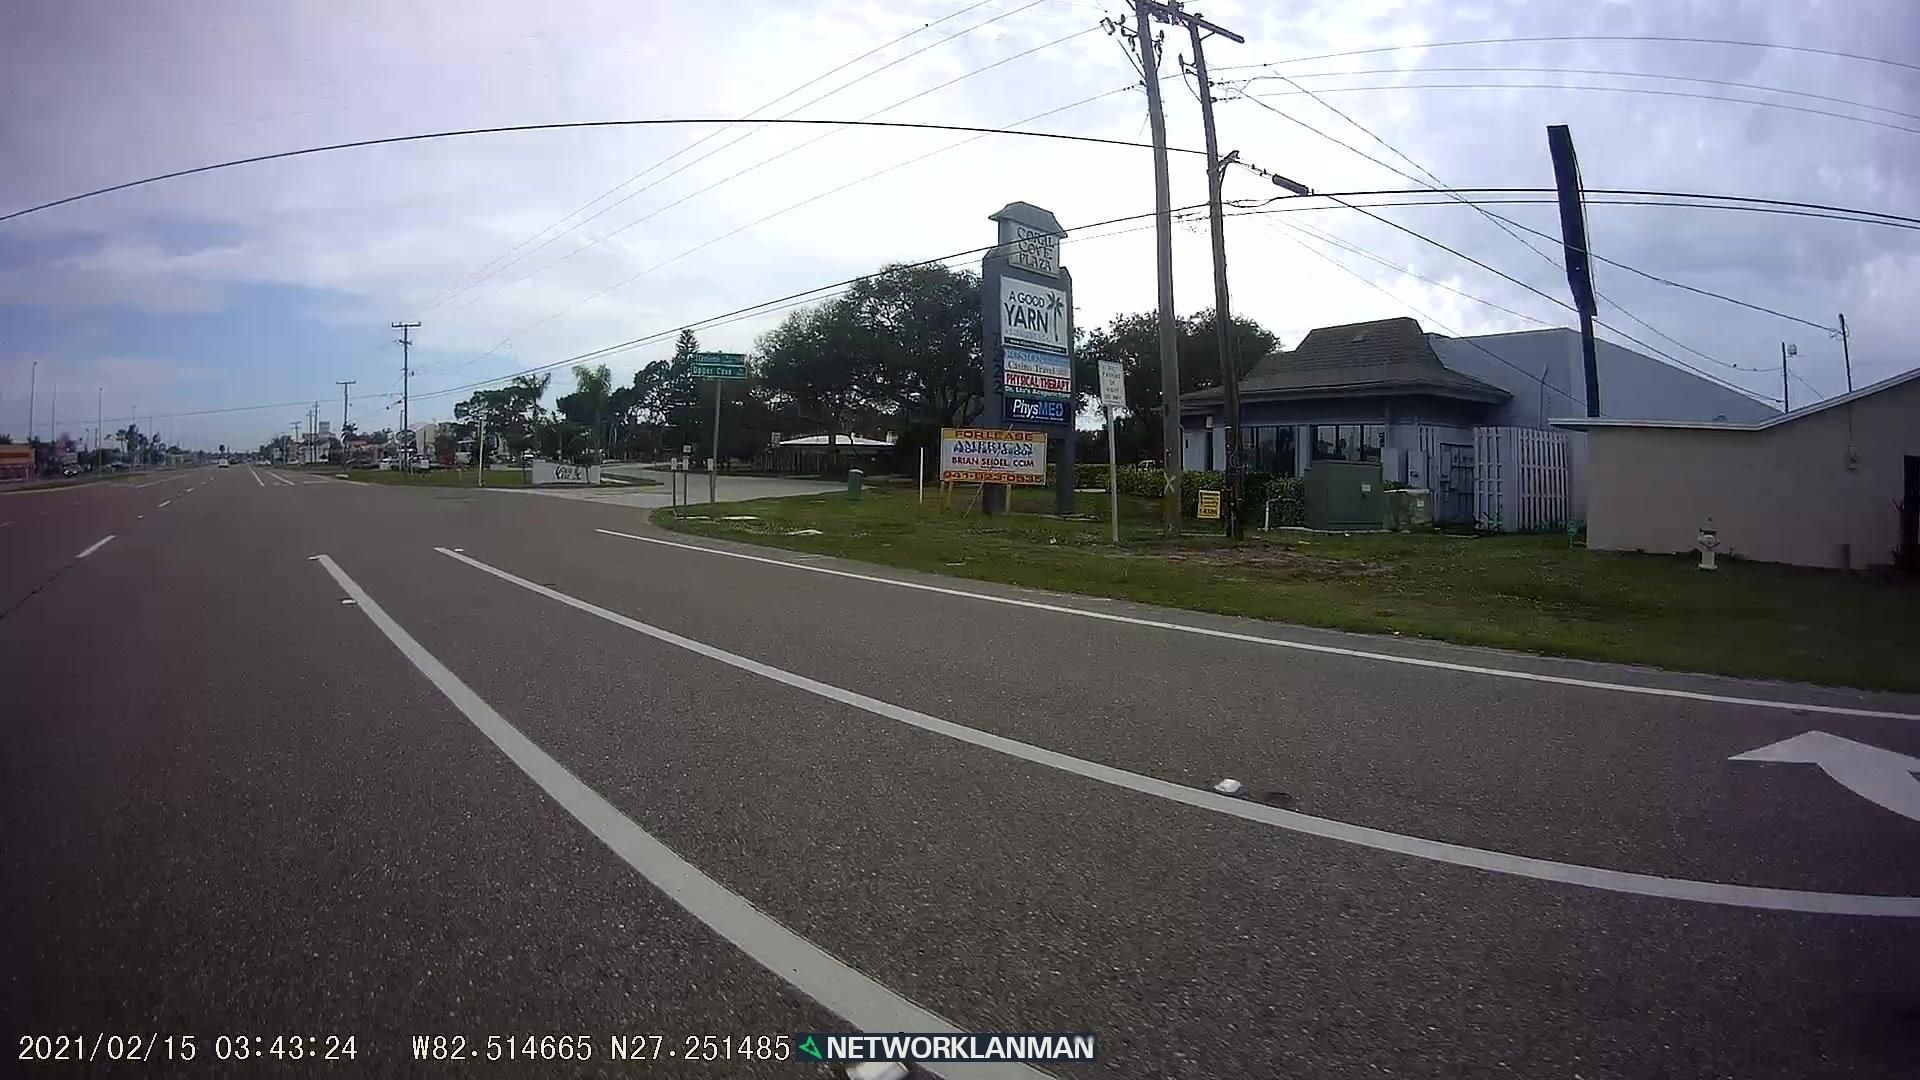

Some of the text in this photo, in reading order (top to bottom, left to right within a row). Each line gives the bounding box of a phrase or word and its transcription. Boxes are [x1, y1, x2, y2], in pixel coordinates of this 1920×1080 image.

[1019, 252, 1052, 271] PLAZA
[1009, 290, 1045, 308] A GOOD
[1004, 303, 1048, 333] YARN
[1007, 373, 1070, 391] PHYSICAL THERAPY
[1013, 399, 1064, 418] PhysMED
[955, 430, 1033, 441] FOR LEASE
[952, 457, 979, 465] BRIAN
